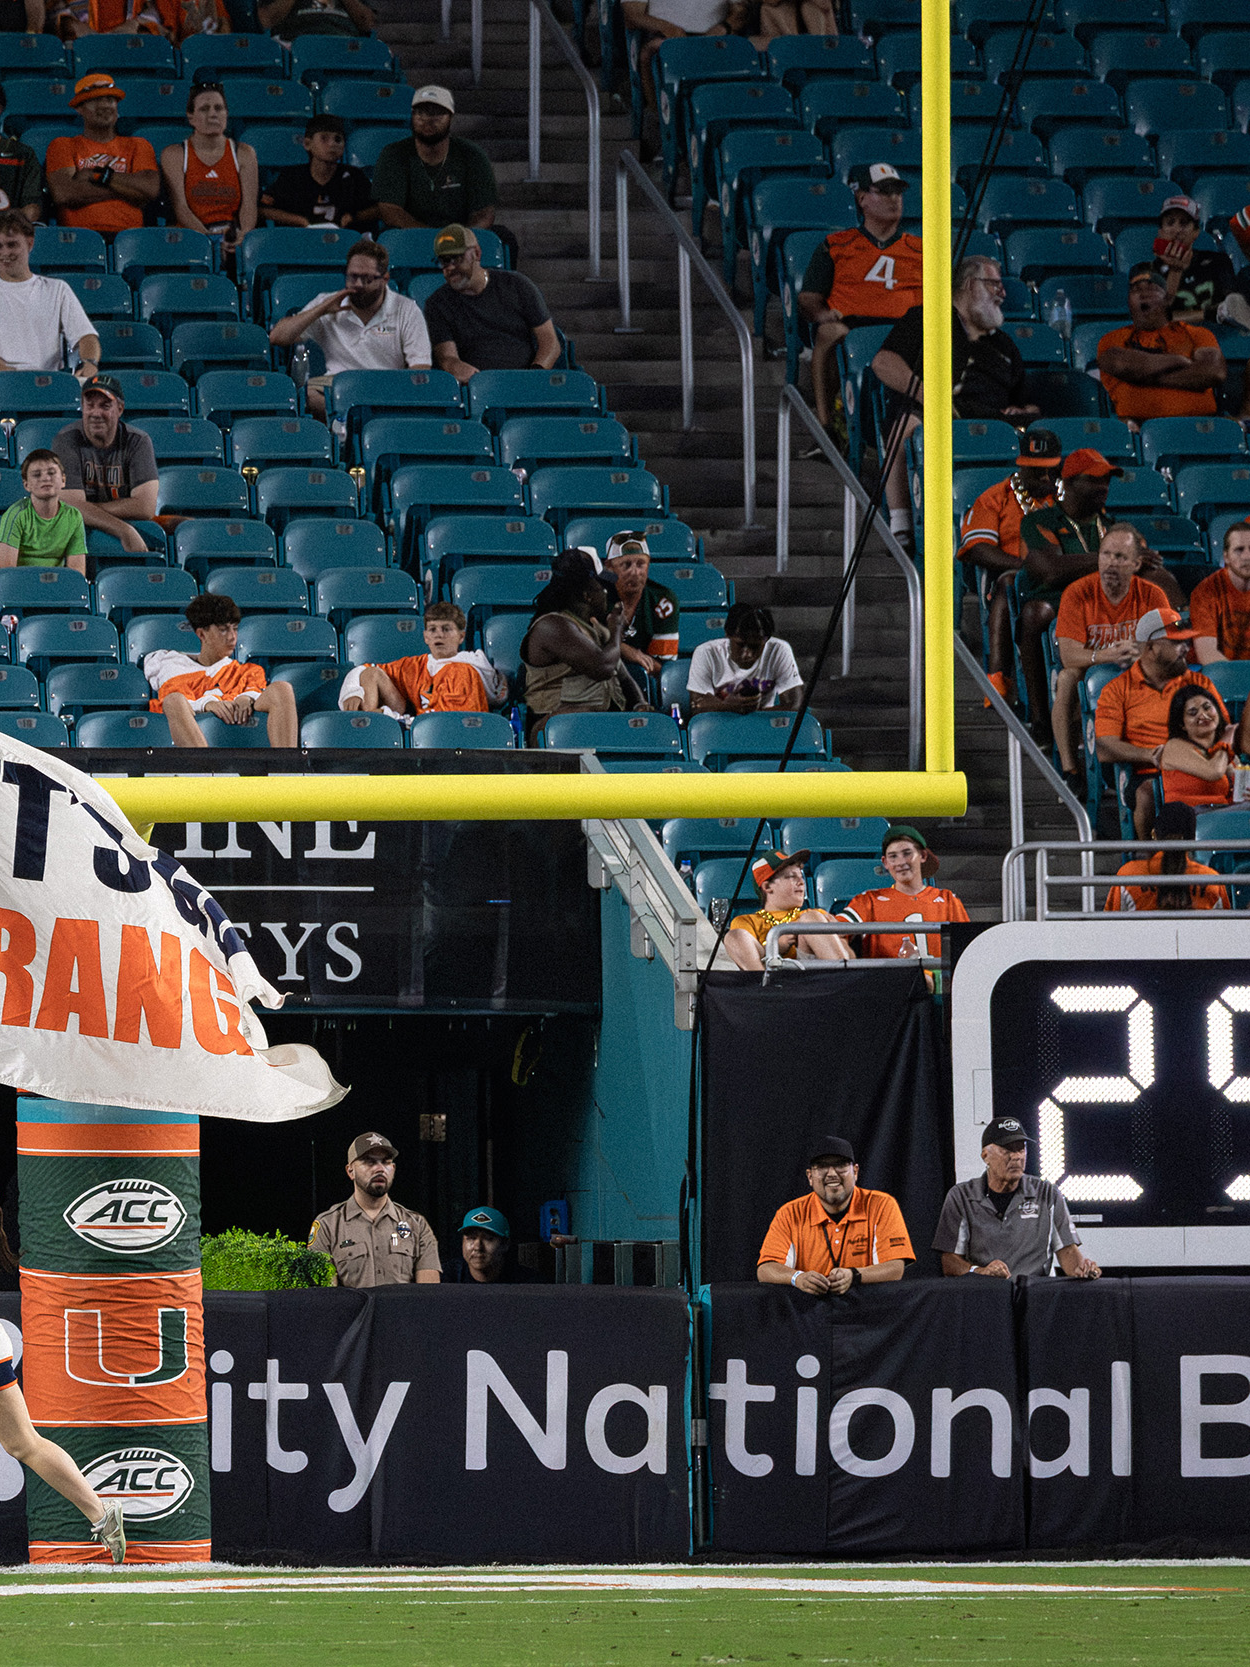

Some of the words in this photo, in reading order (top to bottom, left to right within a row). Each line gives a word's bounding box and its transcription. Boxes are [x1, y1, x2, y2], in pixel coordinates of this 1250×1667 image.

[864, 254, 899, 290] 4
[84, 1199, 174, 1223] ACC
[63, 1307, 190, 1388] U
[209, 1349, 411, 1513] ity
[465, 1348, 1132, 1479] National
[94, 1466, 180, 1492] ACC
